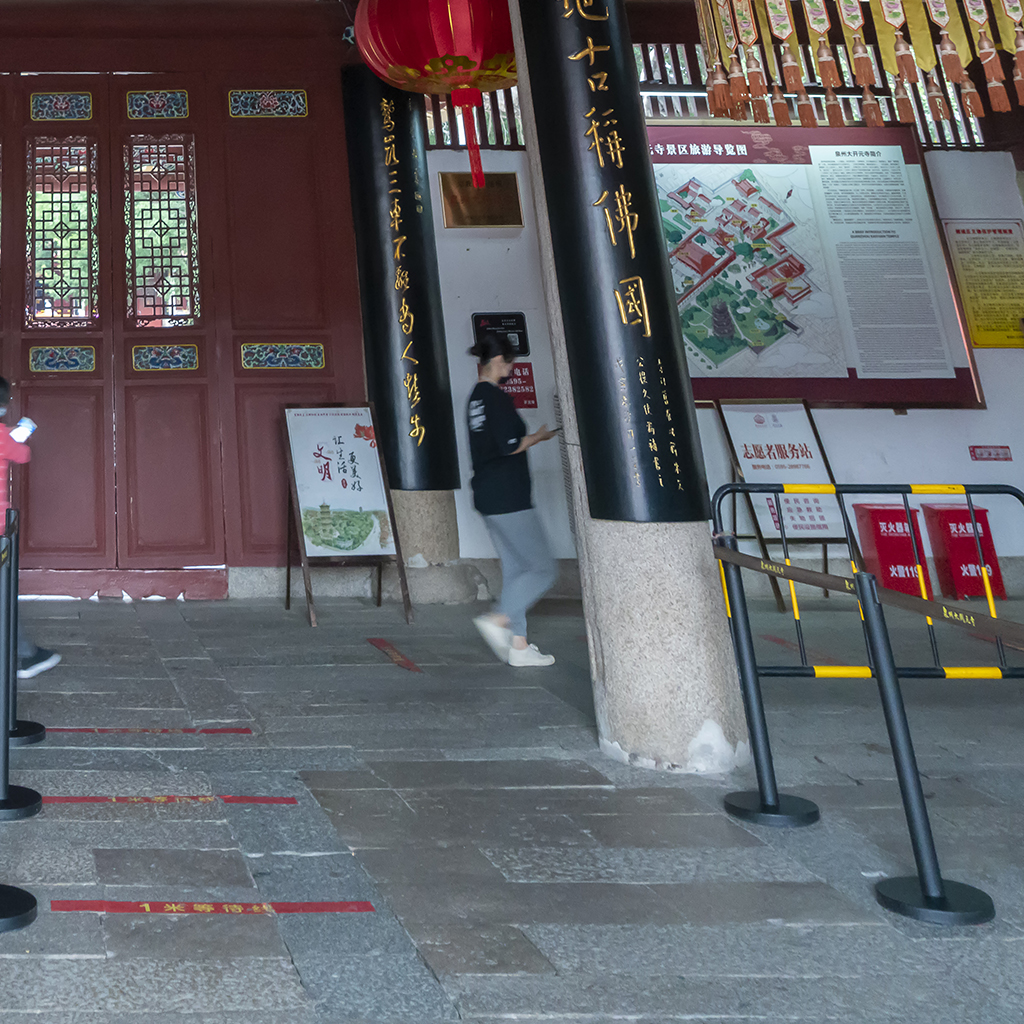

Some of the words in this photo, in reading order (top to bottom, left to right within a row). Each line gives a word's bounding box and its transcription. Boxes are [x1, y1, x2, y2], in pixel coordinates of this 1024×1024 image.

[313, 444, 332, 481] 文明
[332, 435, 348, 474] 让生活
[741, 443, 813, 460] 志愿者服务站
[347, 451, 364, 492] 更美好
[960, 564, 993, 577] 火警19
